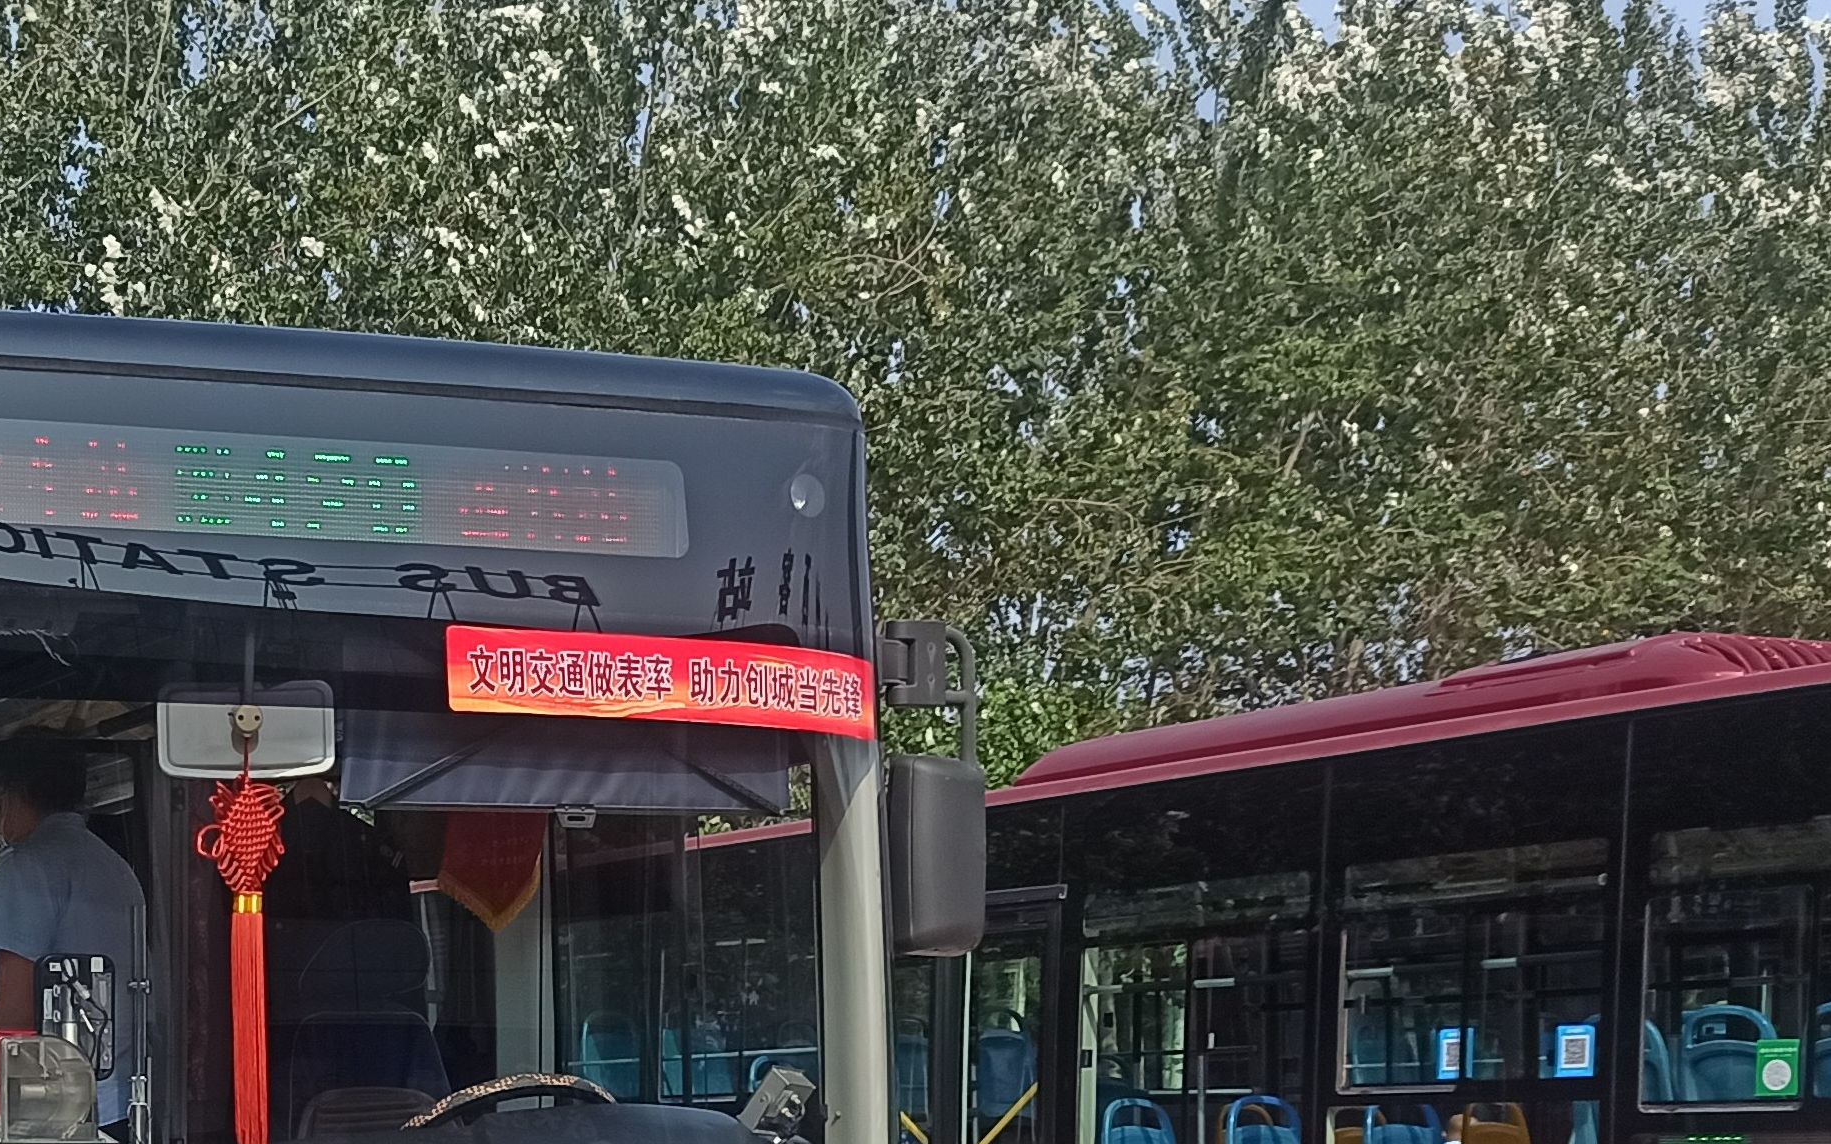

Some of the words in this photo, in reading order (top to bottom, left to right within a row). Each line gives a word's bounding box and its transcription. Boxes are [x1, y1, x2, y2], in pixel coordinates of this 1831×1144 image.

[467, 644, 674, 702] 文明交通做表率
[687, 659, 864, 721] 助力创城当先锋
